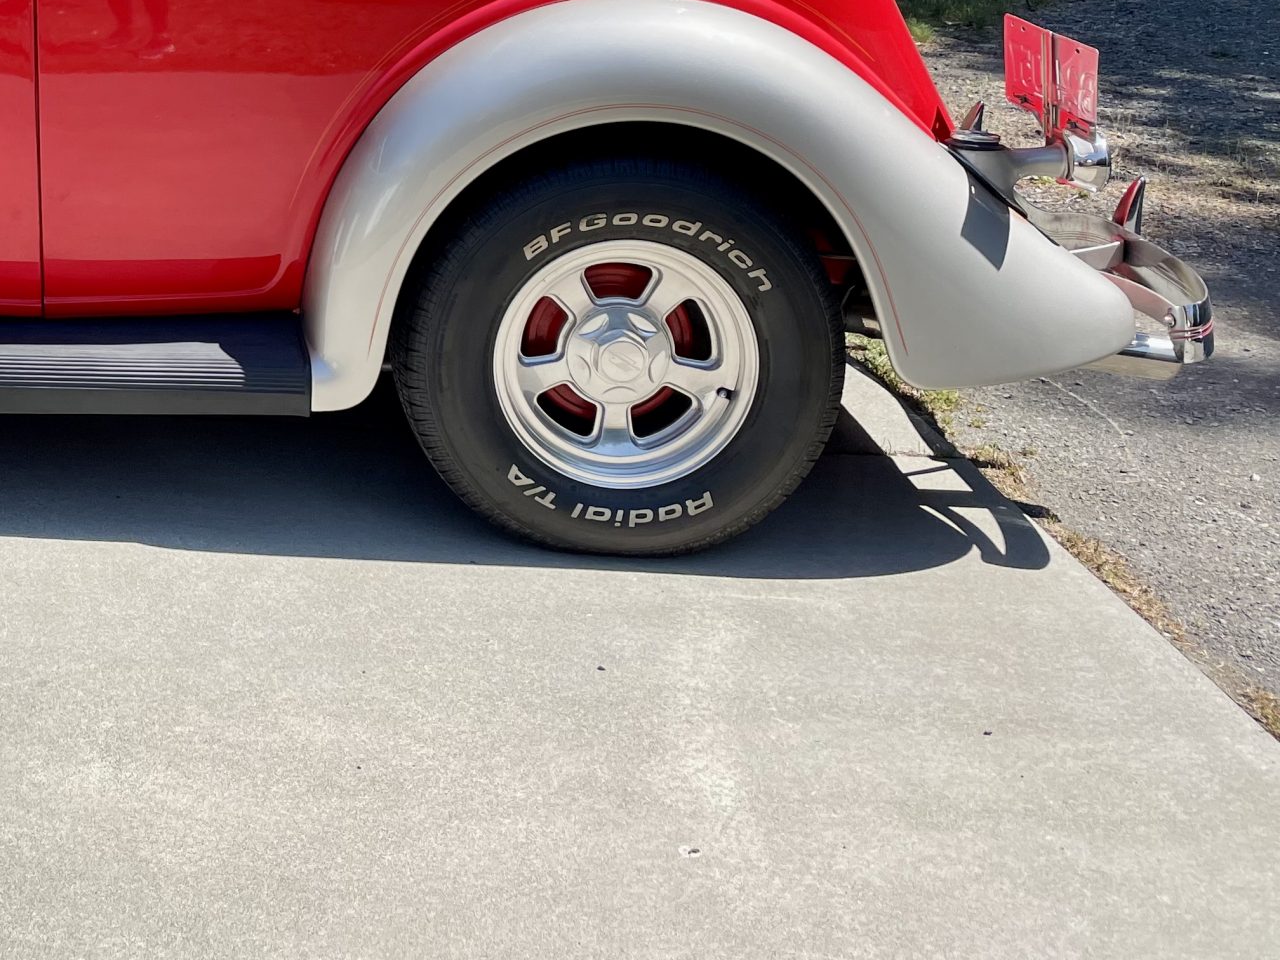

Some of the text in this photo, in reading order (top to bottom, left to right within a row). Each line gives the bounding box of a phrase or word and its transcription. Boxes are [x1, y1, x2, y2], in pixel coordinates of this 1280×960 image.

[523, 212, 773, 293] BFGoodrich
[506, 463, 715, 528] Radial T/A
